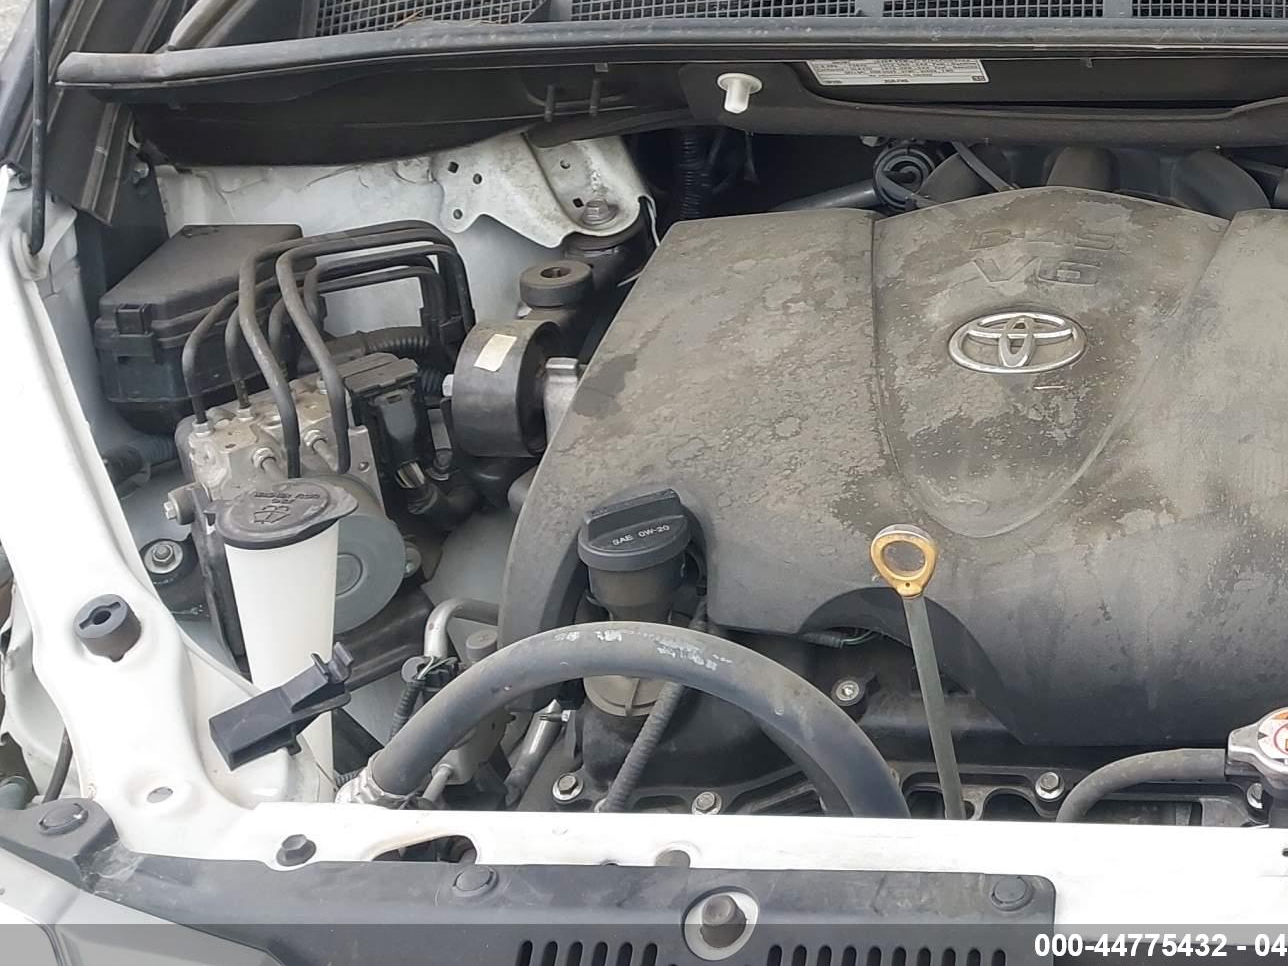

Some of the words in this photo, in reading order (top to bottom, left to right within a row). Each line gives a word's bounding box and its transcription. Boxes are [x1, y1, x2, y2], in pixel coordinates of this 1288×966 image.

[971, 257, 1102, 287] V6
[612, 535, 634, 546] SAE
[638, 524, 671, 538] 0W-20
